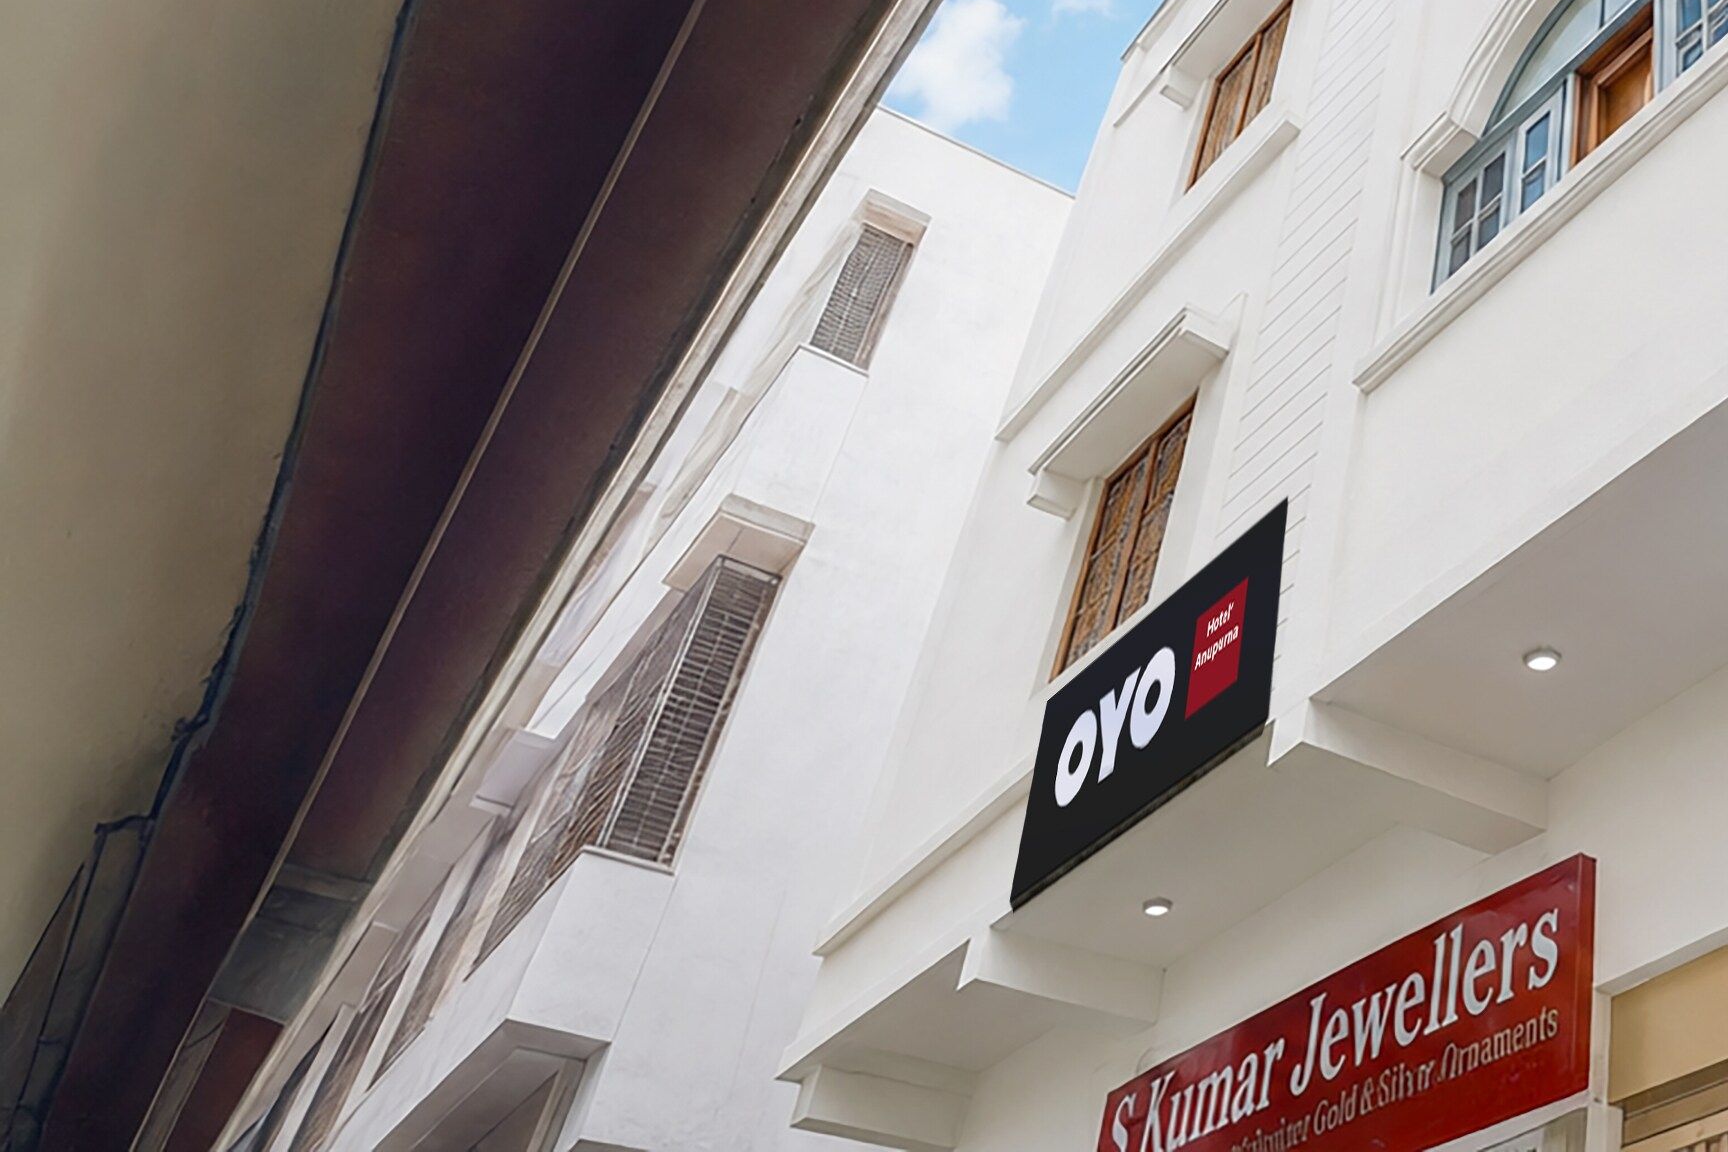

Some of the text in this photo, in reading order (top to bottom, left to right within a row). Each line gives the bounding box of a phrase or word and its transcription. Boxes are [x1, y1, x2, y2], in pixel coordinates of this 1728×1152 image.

[1206, 603, 1233, 637] Hotel
[1054, 646, 1175, 807] OYO
[1290, 908, 1560, 1096] Jewellers
[1313, 1082, 1357, 1136] Gold
[1438, 1006, 1560, 1081] Ornaments
